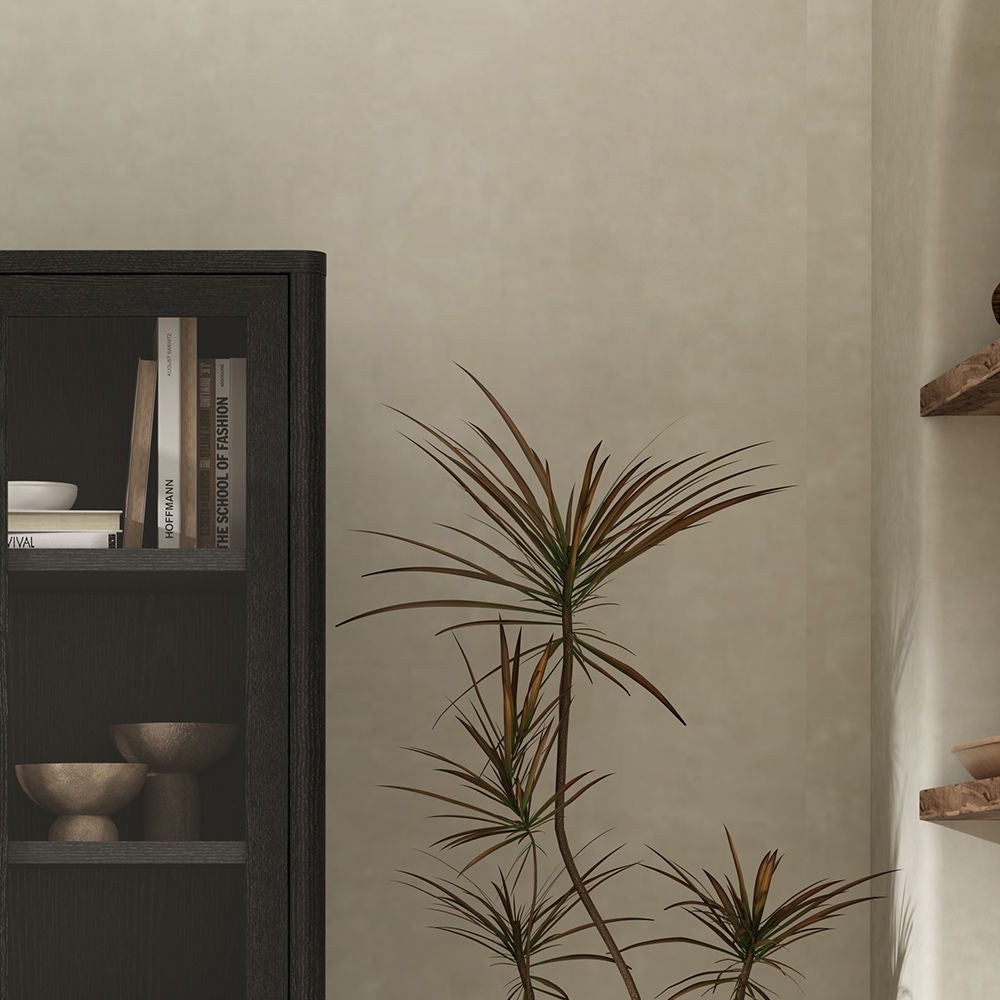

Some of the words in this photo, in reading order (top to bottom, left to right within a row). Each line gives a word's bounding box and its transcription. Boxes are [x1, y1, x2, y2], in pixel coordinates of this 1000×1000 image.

[216, 397, 228, 450] FASHION
[216, 454, 228, 470] OF
[165, 479, 174, 539] HOFFMANN
[216, 473, 228, 523] SCHOOL
[216, 527, 228, 549] THE
